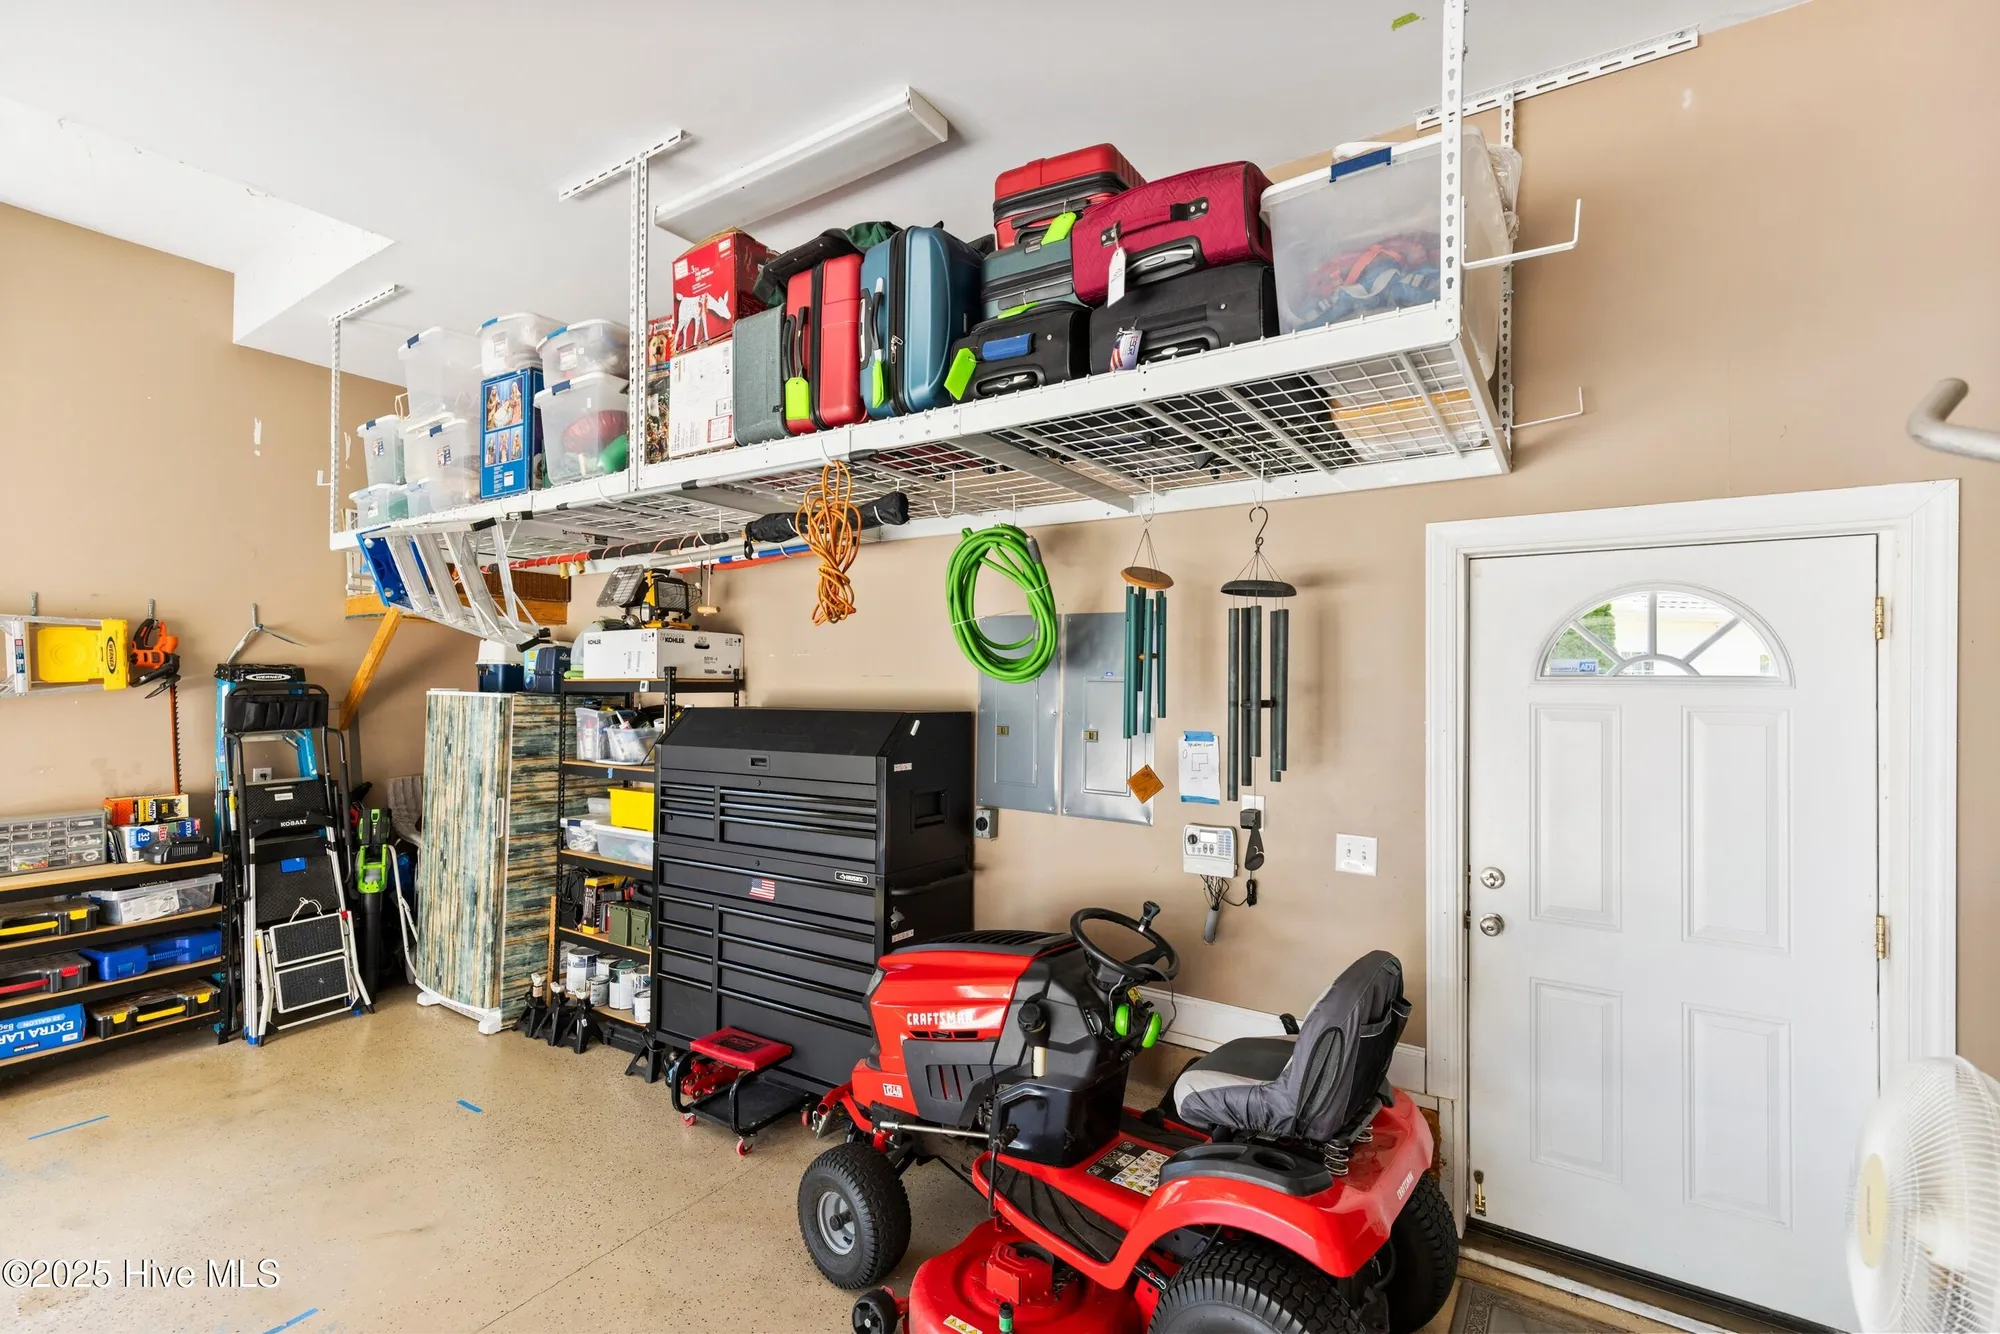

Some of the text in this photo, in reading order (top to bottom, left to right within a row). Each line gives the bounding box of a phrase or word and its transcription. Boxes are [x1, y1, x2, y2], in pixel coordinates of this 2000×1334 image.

[1580, 662, 1595, 671] ADT
[148, 801, 156, 820] Hefty
[280, 819, 307, 827] KOBALT
[140, 832, 150, 841] 33
[28, 1021, 74, 1038] EXTRA
